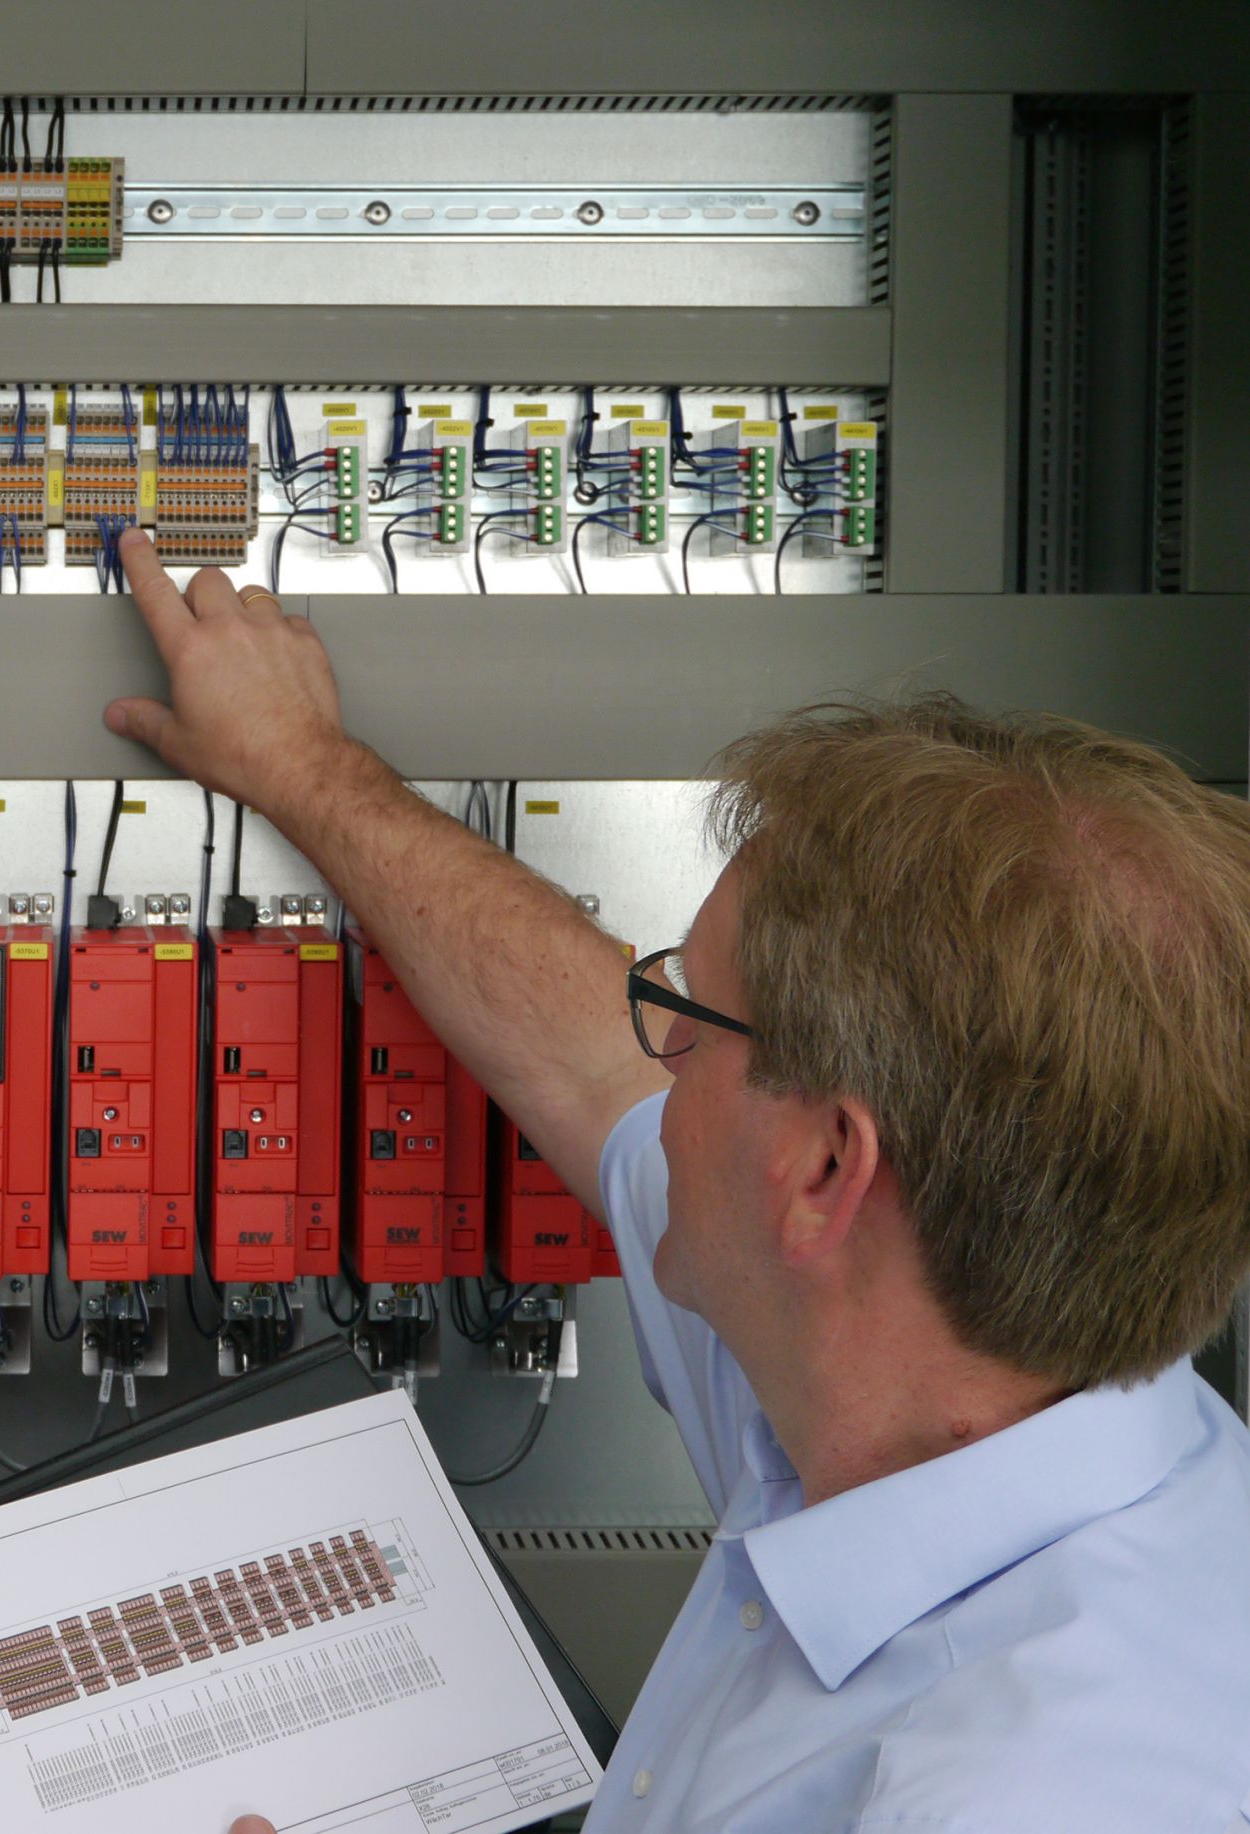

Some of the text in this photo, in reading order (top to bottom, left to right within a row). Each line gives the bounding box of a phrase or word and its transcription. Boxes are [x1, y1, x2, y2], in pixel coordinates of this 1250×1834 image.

[92, 1230, 127, 1243] SEW
[238, 1231, 274, 1244] SEW
[386, 1226, 421, 1241] SEW
[534, 1232, 569, 1246] SEW
